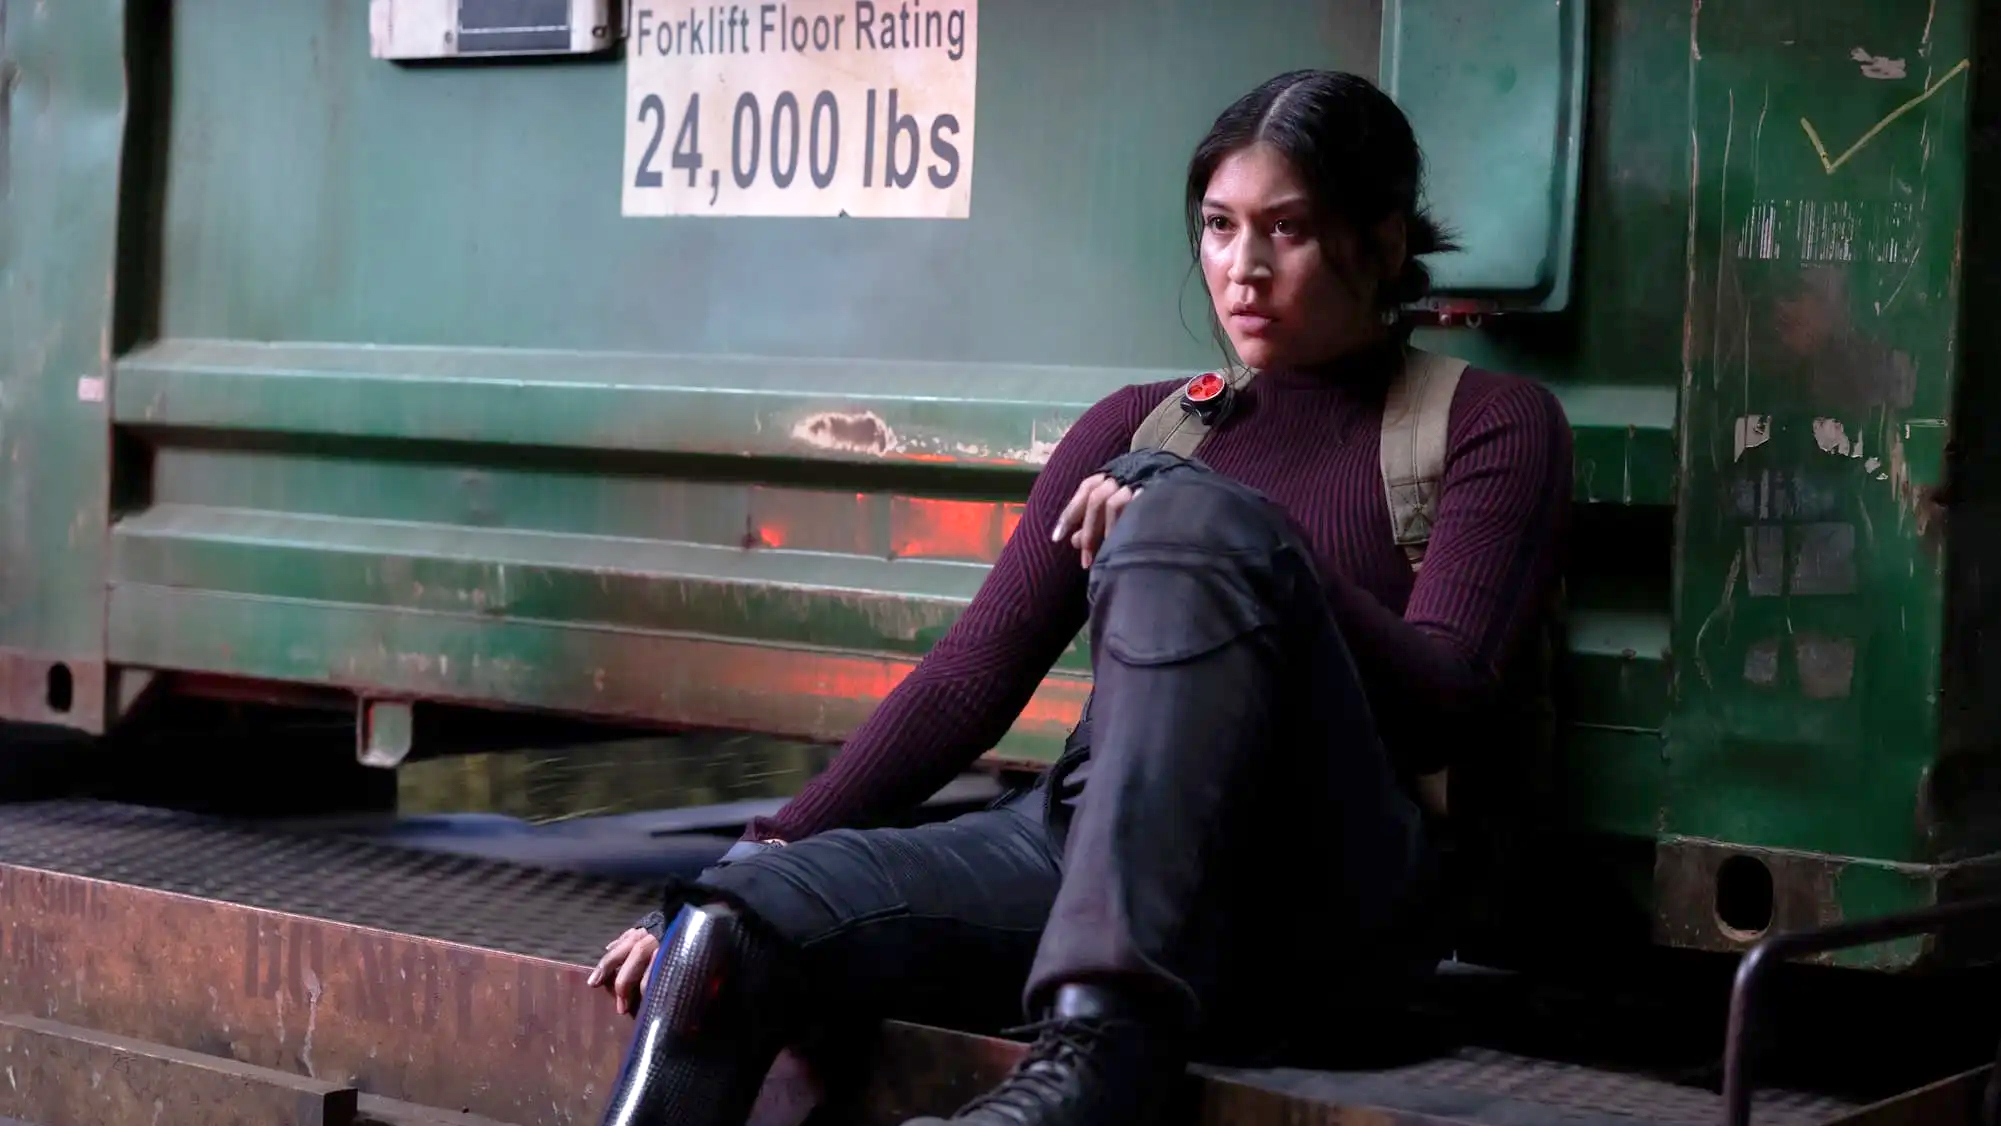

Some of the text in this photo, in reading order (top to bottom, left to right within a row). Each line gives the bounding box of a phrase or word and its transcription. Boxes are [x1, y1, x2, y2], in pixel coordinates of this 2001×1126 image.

[637, 0, 965, 60] Forklift Floor Rating
[634, 88, 961, 206] 24,000 lbs
